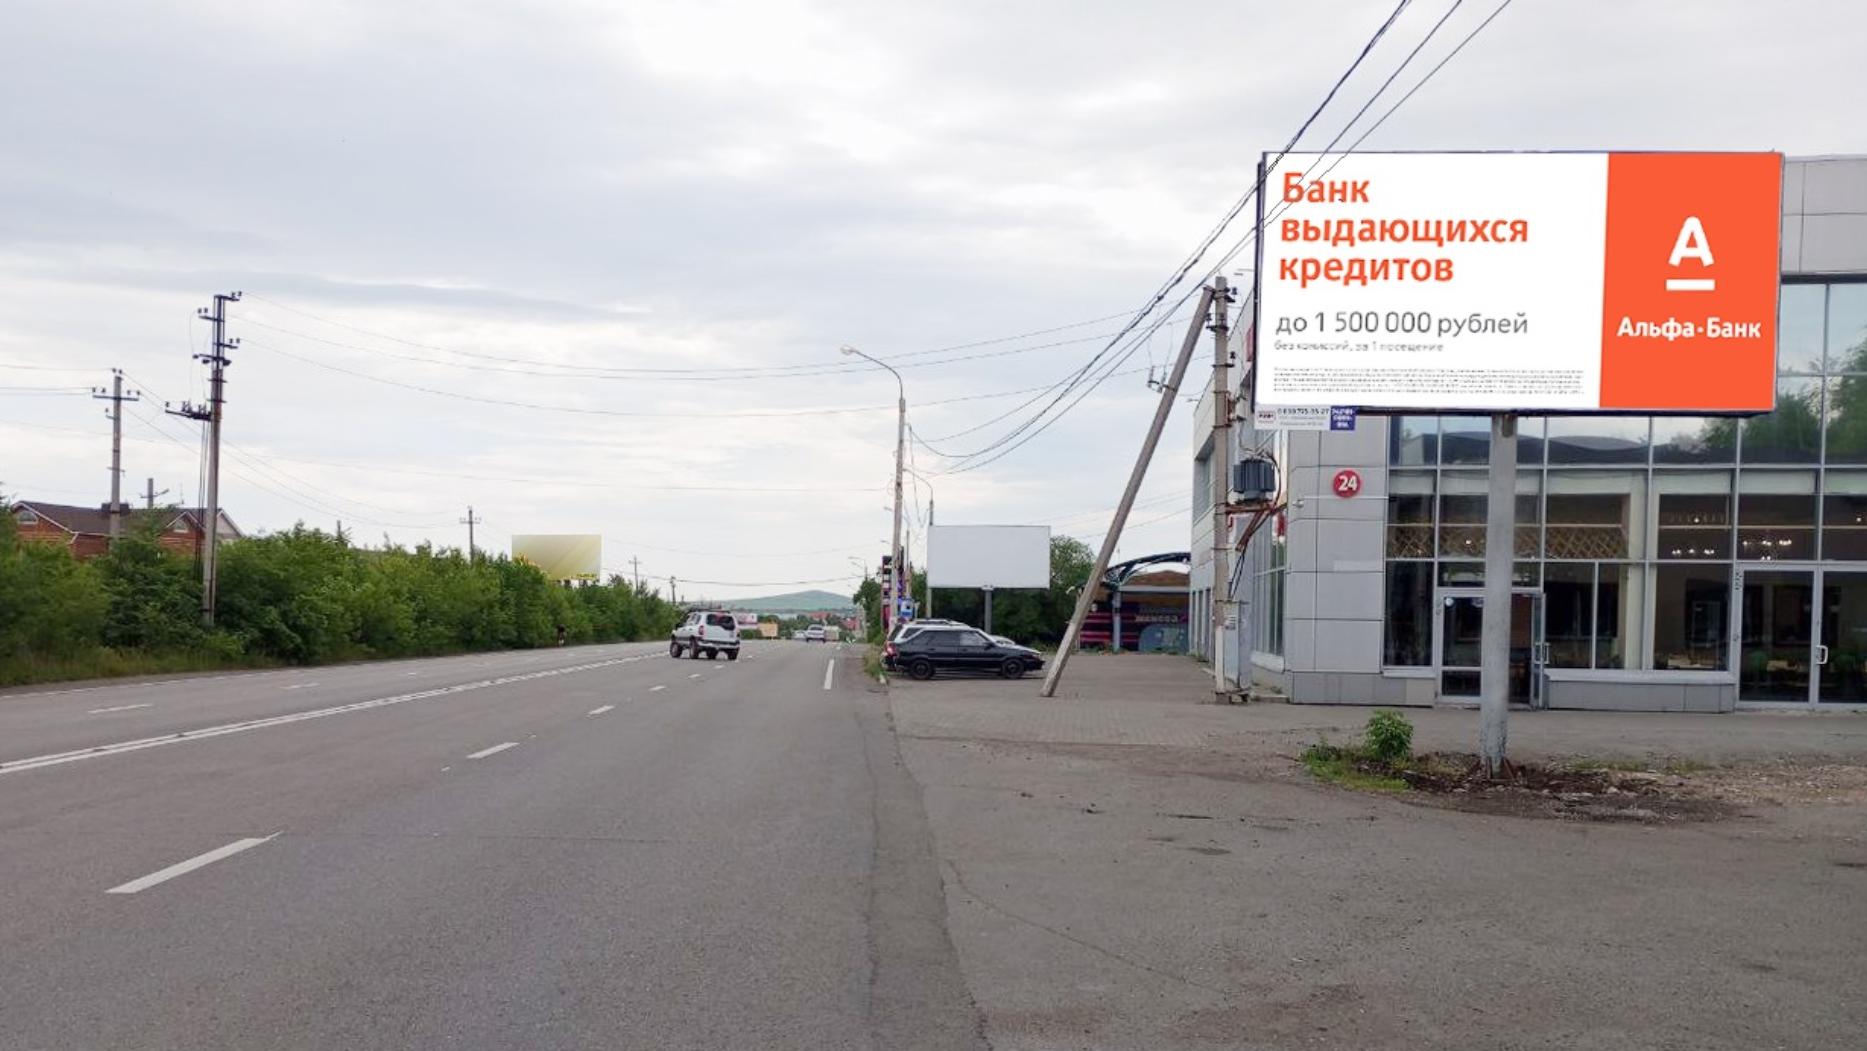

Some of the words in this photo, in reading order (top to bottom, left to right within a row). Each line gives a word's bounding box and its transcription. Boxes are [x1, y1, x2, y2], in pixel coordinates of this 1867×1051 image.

[1283, 172, 1370, 204] Банк
[1281, 218, 1529, 248] выдающихся
[1669, 216, 1715, 267] А
[1279, 257, 1454, 289] кредитов
[1275, 316, 1308, 335] до
[1315, 311, 1325, 333] 1
[1335, 311, 1379, 333] 500
[1385, 311, 1432, 334] 000
[1437, 312, 1528, 338] рублей
[1274, 339, 1295, 351] без
[1338, 475, 1358, 491] 24
